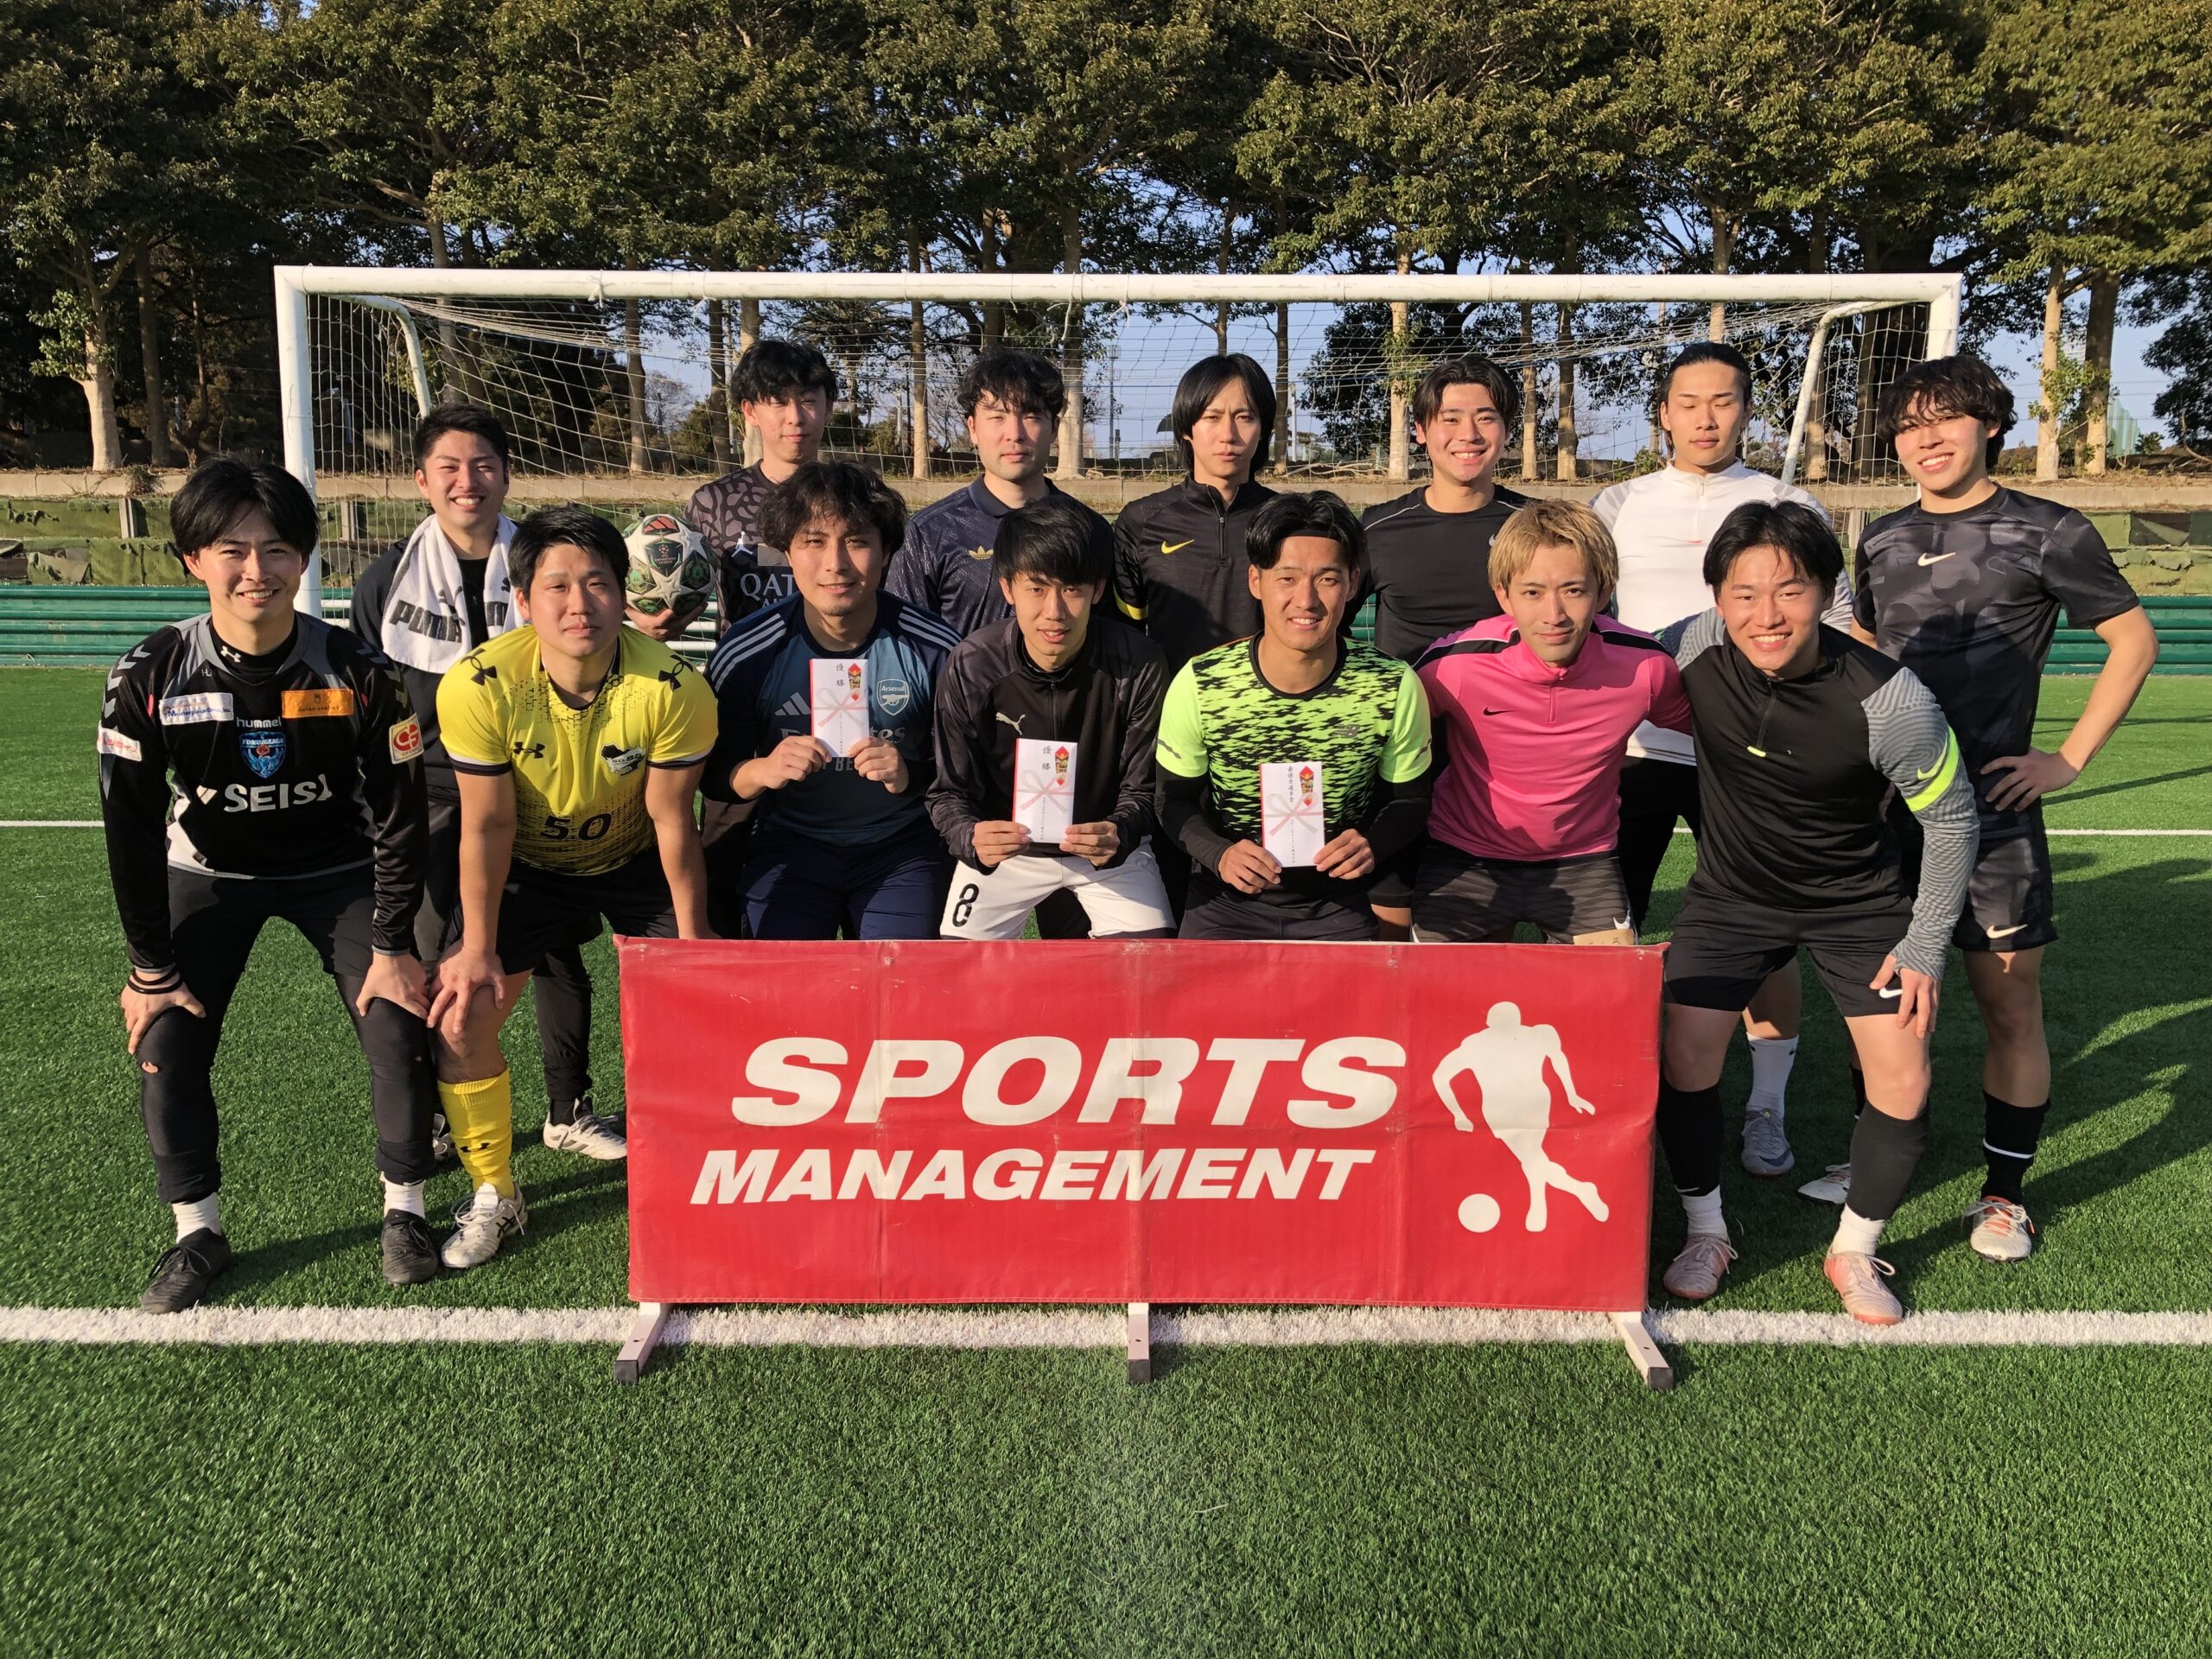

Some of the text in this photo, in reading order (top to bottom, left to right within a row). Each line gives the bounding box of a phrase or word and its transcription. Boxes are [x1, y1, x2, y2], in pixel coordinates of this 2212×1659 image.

[740, 573, 794, 601] QAT
[389, 600, 462, 643] PUMA
[236, 716, 282, 728] hummel
[1042, 746, 1052, 771] 優勝
[539, 812, 613, 841] 50
[952, 883, 979, 927] 8
[731, 1035, 1407, 1129] SPORTS
[690, 1147, 1376, 1205] MANAGEMENT
